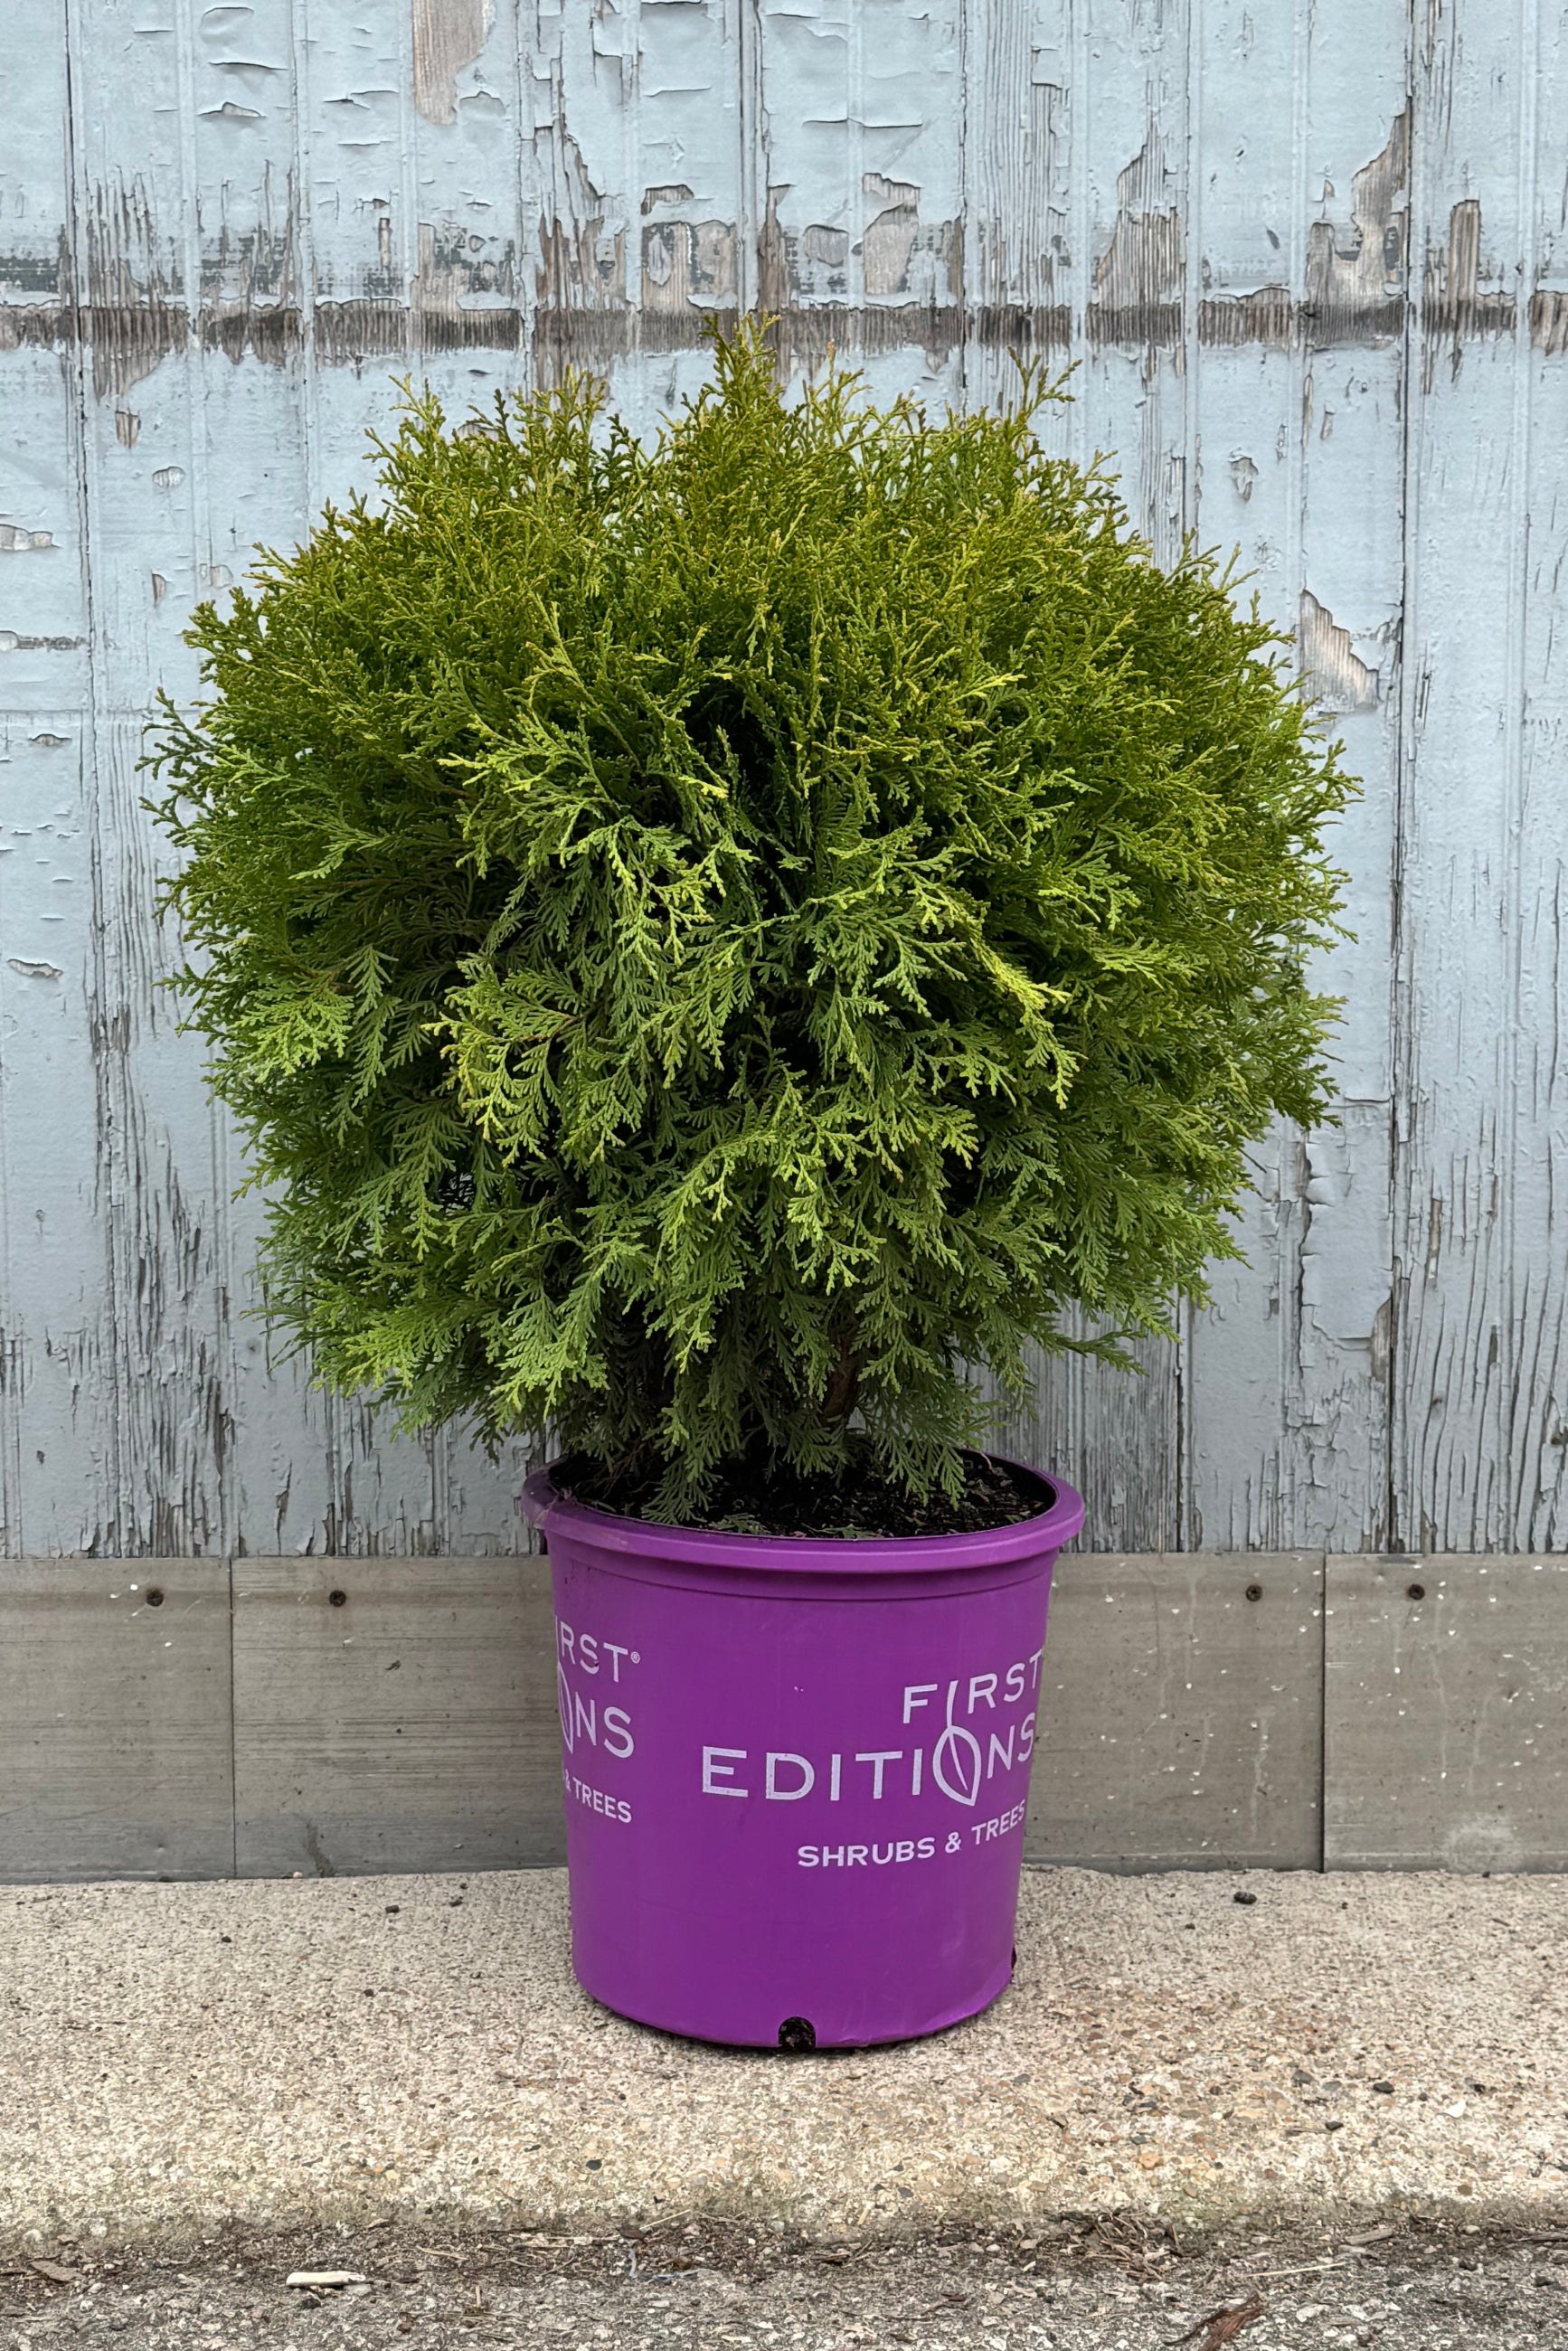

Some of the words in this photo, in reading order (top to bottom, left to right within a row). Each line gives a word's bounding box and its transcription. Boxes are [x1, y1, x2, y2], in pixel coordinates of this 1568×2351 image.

[902, 1648, 1044, 1726] FIRST
[702, 1712, 1036, 1807] EDITIONS
[572, 1777, 632, 1824] TREES
[798, 1836, 936, 1867] SHRUBS
[944, 1831, 962, 1854] &
[971, 1799, 1025, 1846] TREES
